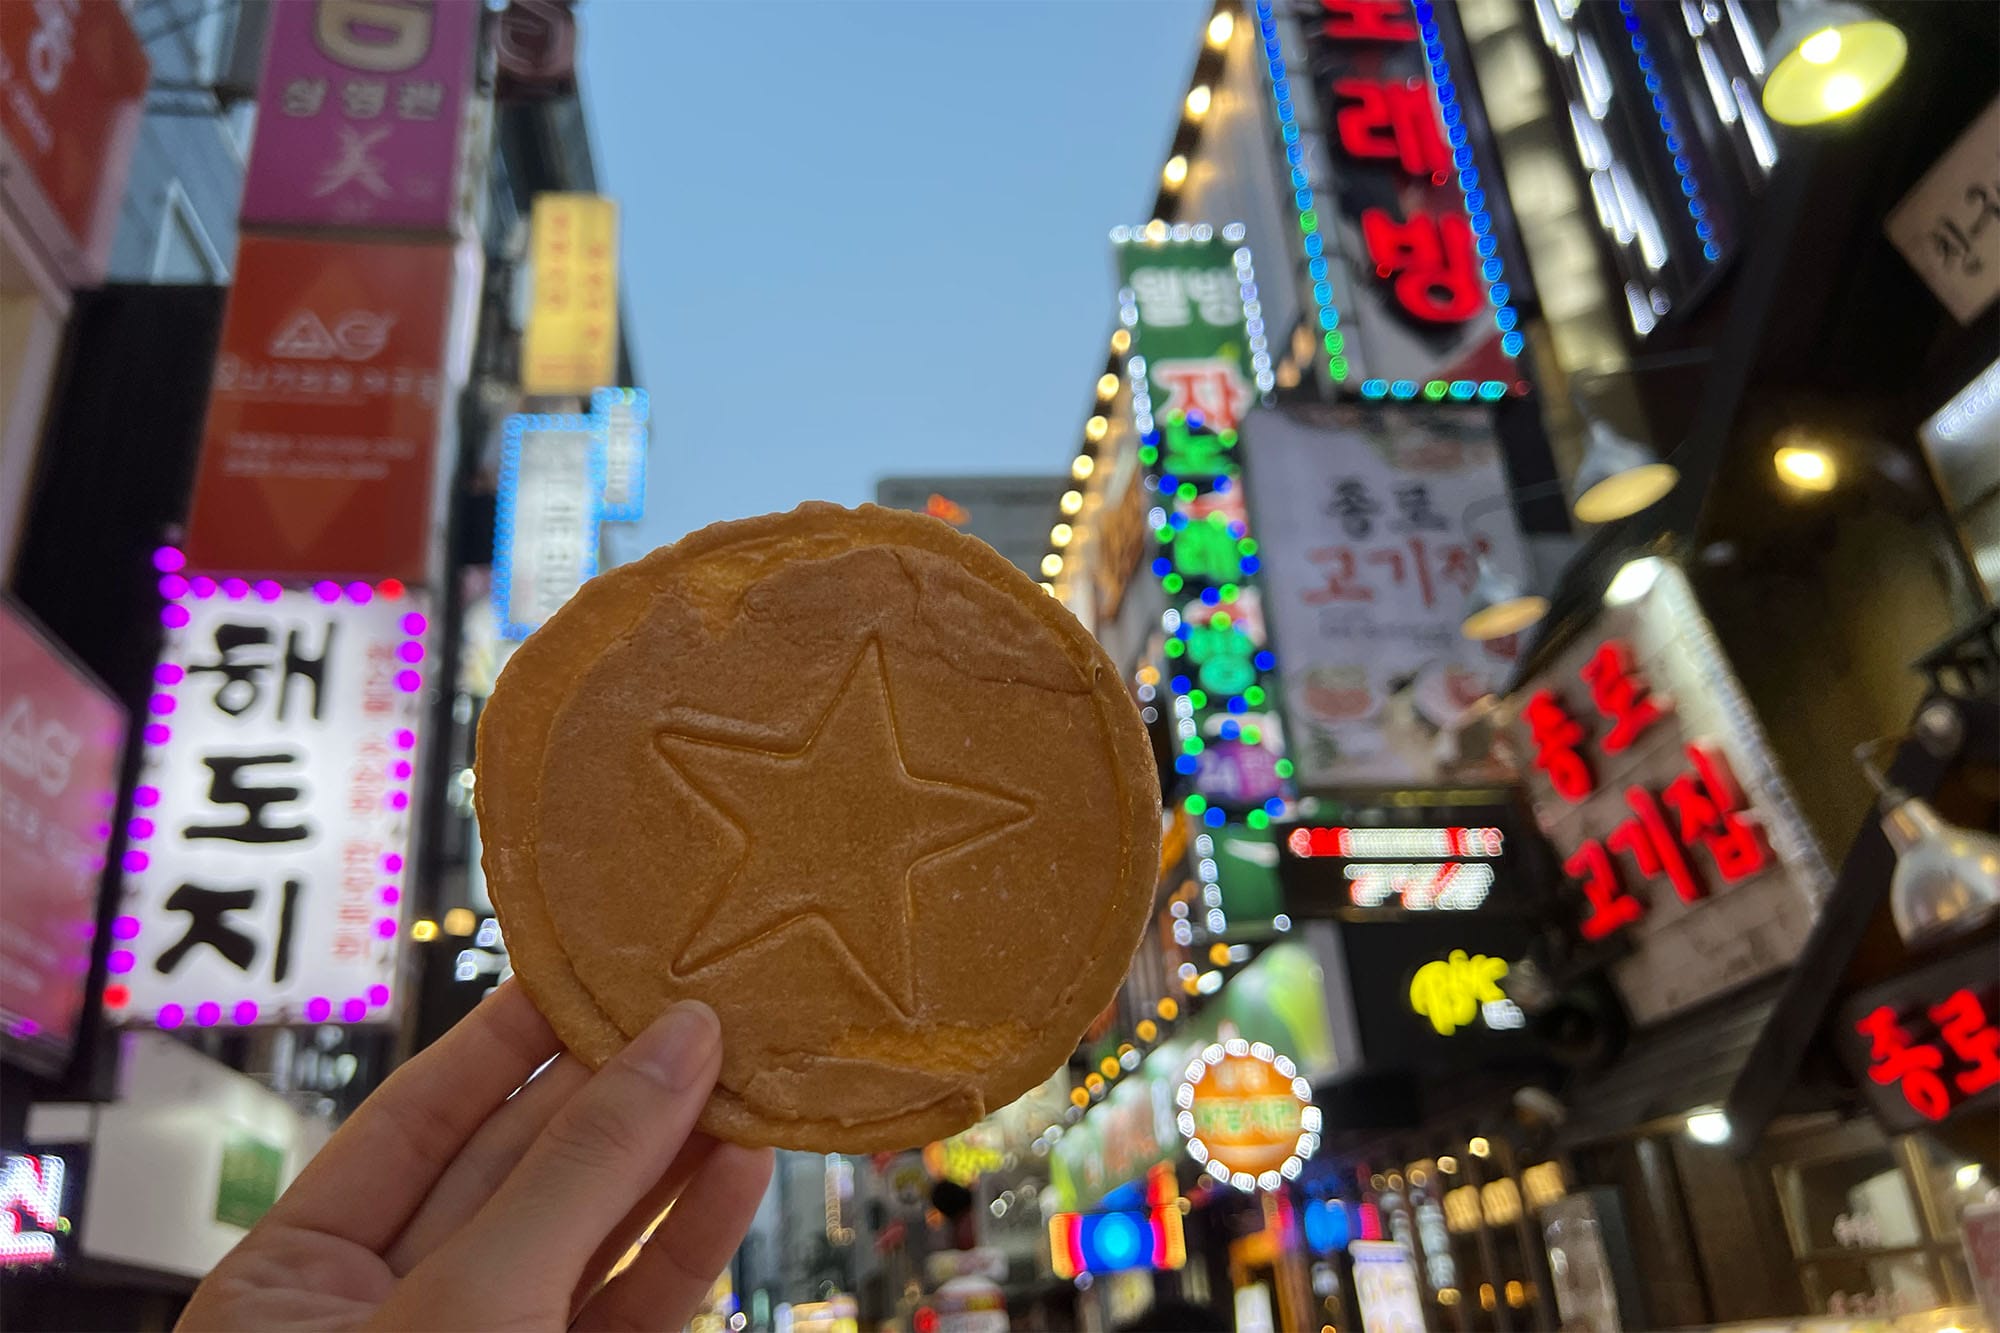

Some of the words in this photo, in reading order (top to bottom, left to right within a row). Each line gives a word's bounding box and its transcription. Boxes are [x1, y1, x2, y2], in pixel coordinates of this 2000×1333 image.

[1323, 476, 1450, 540] 종로
[1522, 640, 1672, 803] 종로
[1564, 743, 1765, 940] 고기집
[1855, 988, 2000, 1121] 종로
